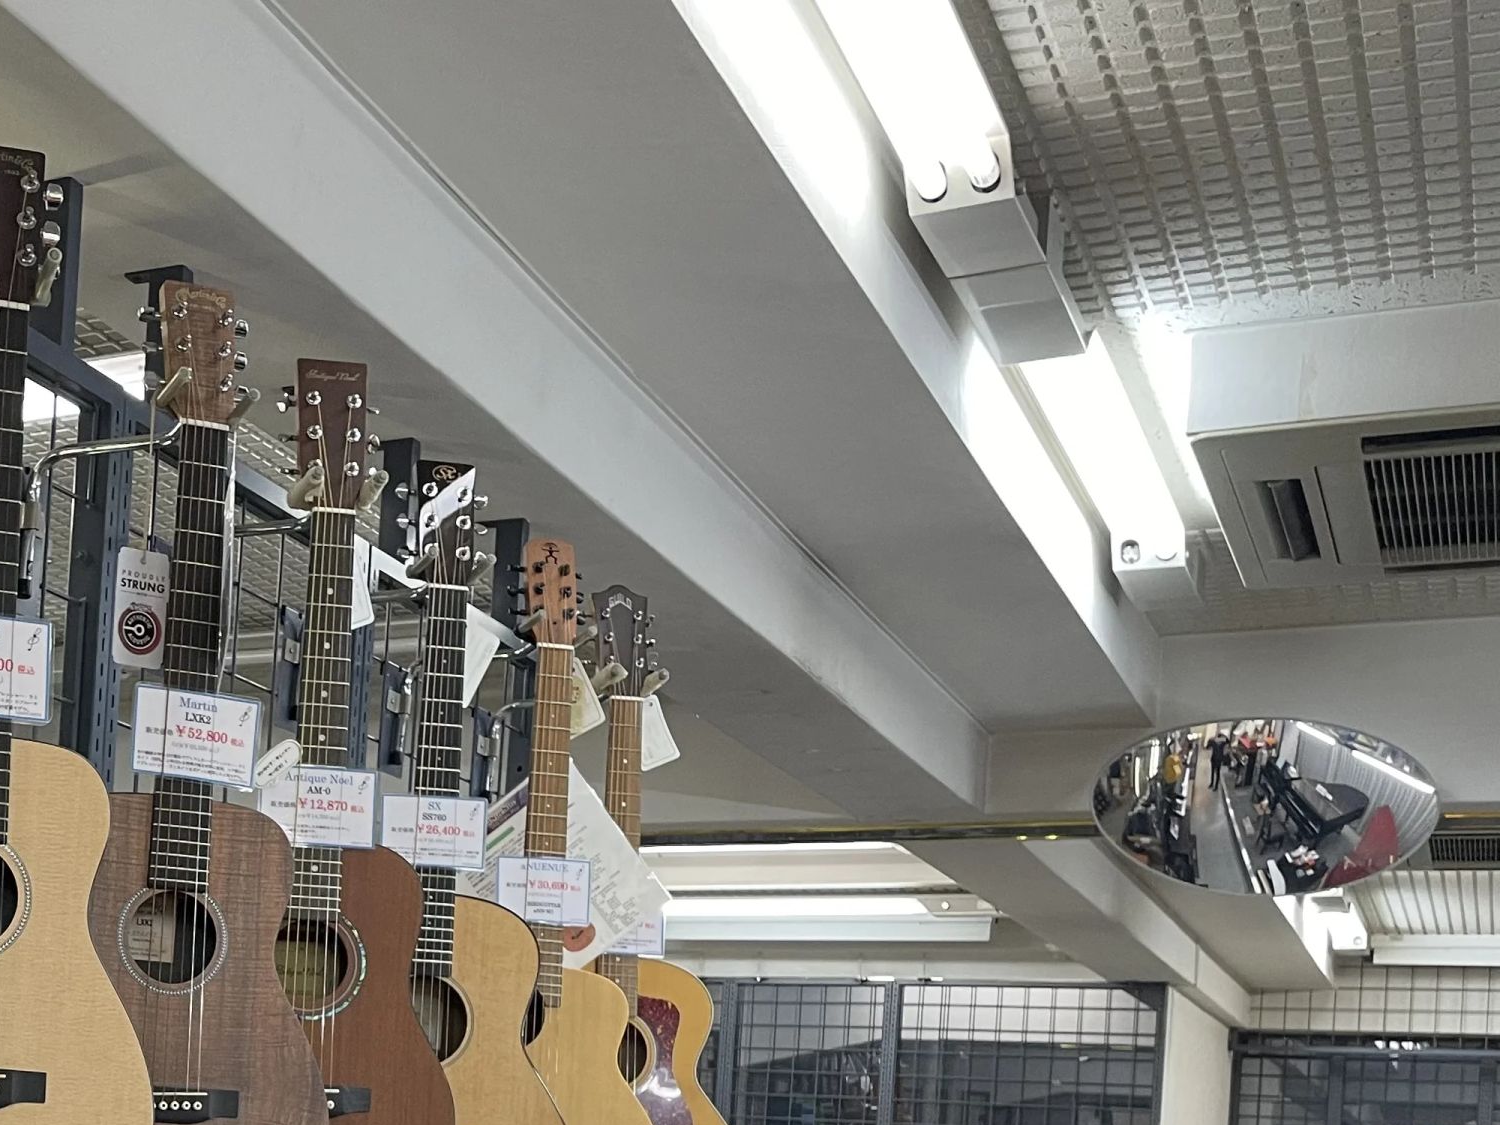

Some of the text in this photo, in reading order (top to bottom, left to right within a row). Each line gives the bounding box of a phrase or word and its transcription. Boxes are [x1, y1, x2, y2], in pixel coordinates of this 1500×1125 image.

[121, 578, 165, 594] STRUNG
[608, 595, 632, 611] GUILD
[179, 696, 218, 713] Martin
[184, 712, 212, 725] LXK2
[176, 724, 228, 744] ¥52,800
[284, 770, 327, 784] Antique
[298, 797, 348, 811] ¥12,870
[428, 800, 442, 811] SX
[416, 823, 461, 836] ¥26,400
